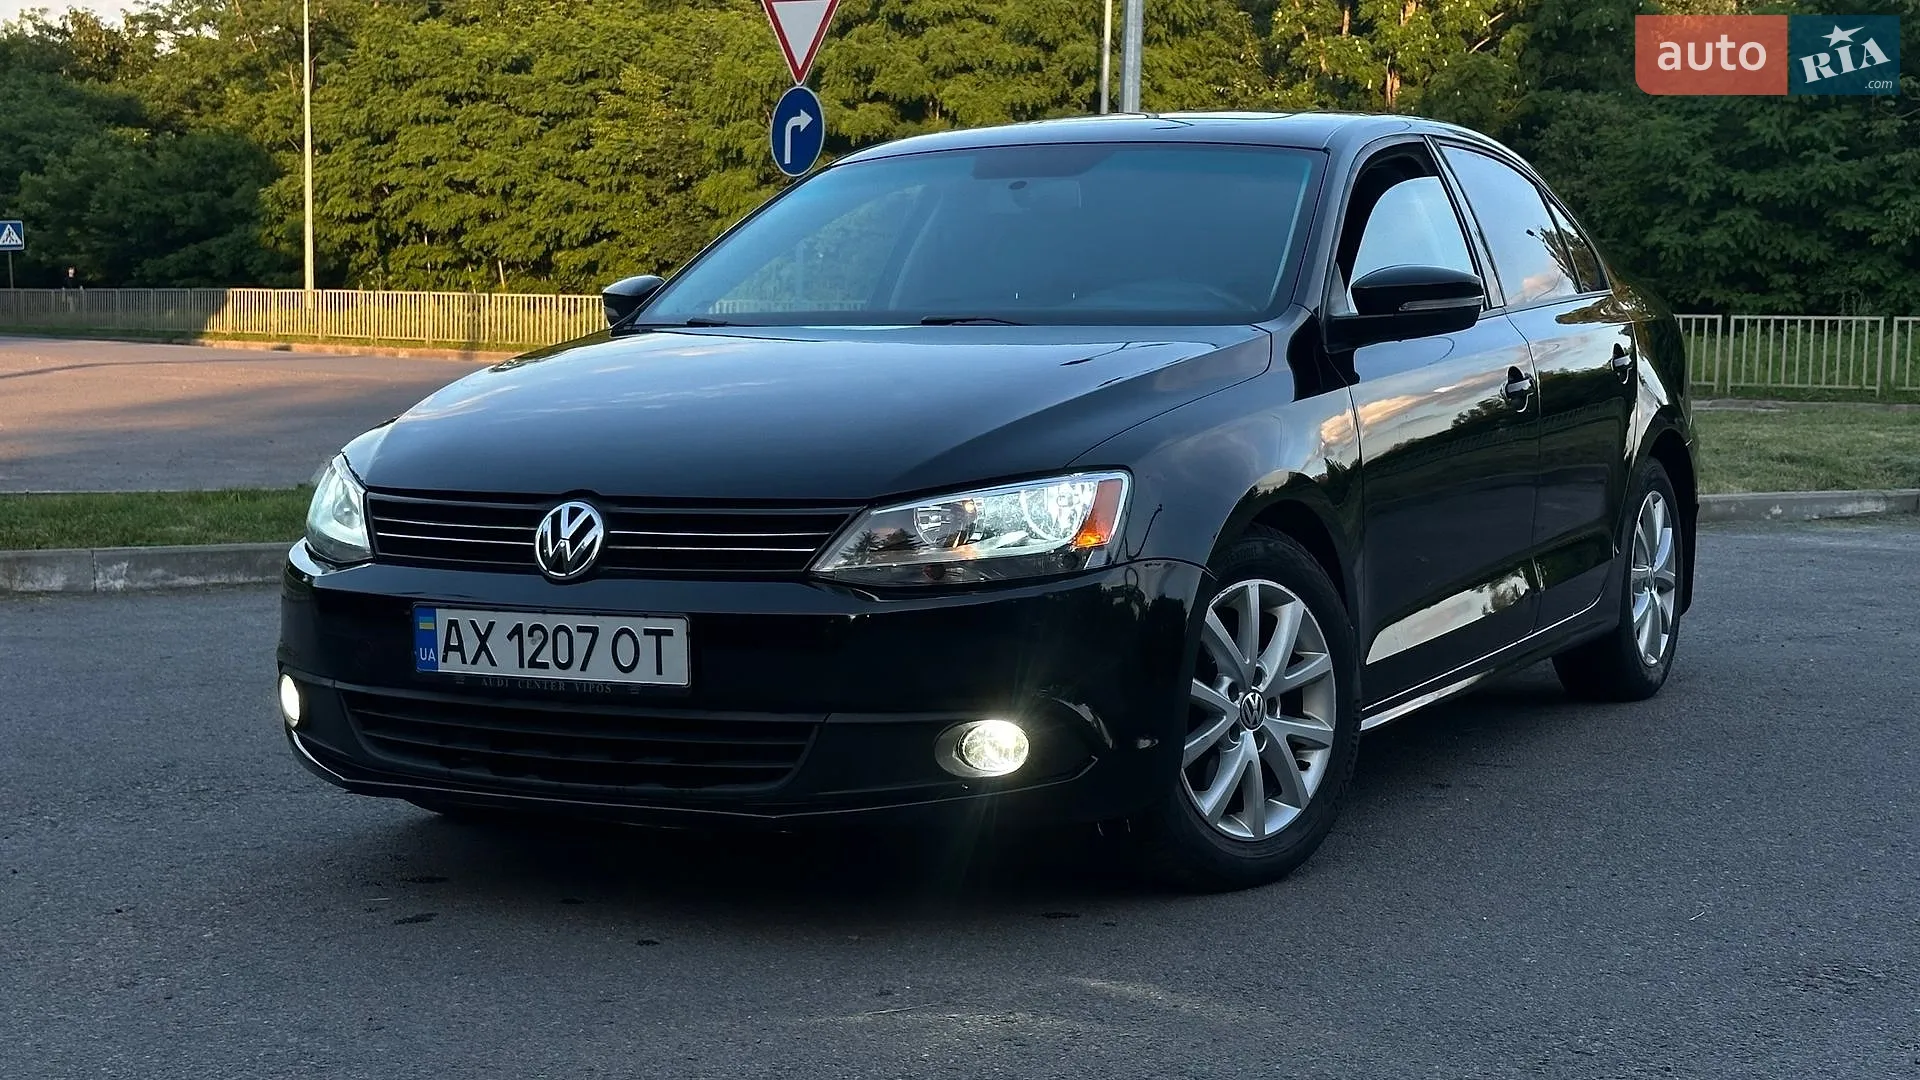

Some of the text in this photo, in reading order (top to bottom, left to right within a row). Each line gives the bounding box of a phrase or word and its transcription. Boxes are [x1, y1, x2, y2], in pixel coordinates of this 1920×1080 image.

[419, 647, 436, 662] UA
[441, 618, 674, 676] AX 1207 OT
[481, 678, 612, 694] AUDI CENTER VIPOS
